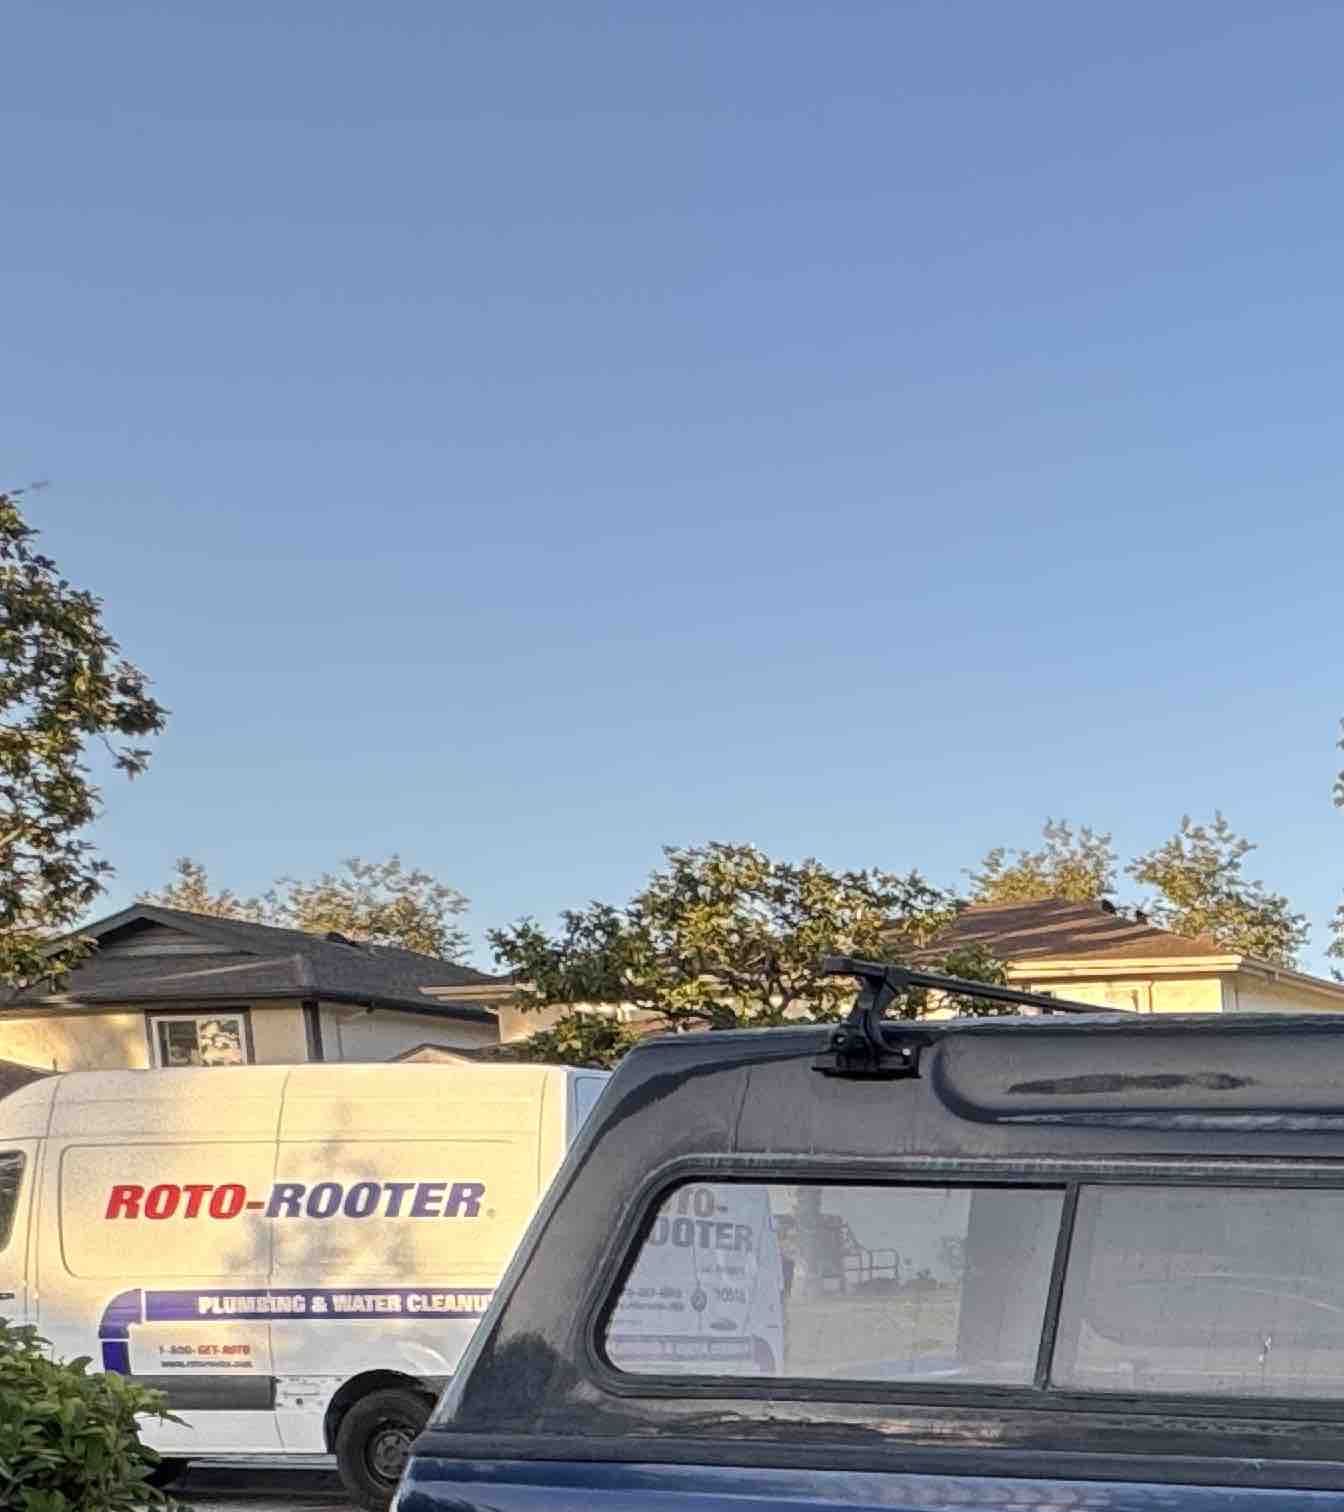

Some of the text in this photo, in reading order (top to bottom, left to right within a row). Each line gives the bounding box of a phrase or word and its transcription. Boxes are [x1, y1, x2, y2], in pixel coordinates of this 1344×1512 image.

[105, 1183, 486, 1220] ROTO-ROOTER
[198, 1295, 306, 1314] PLUMBING
[311, 1295, 328, 1313] &
[332, 1294, 402, 1314] WATER
